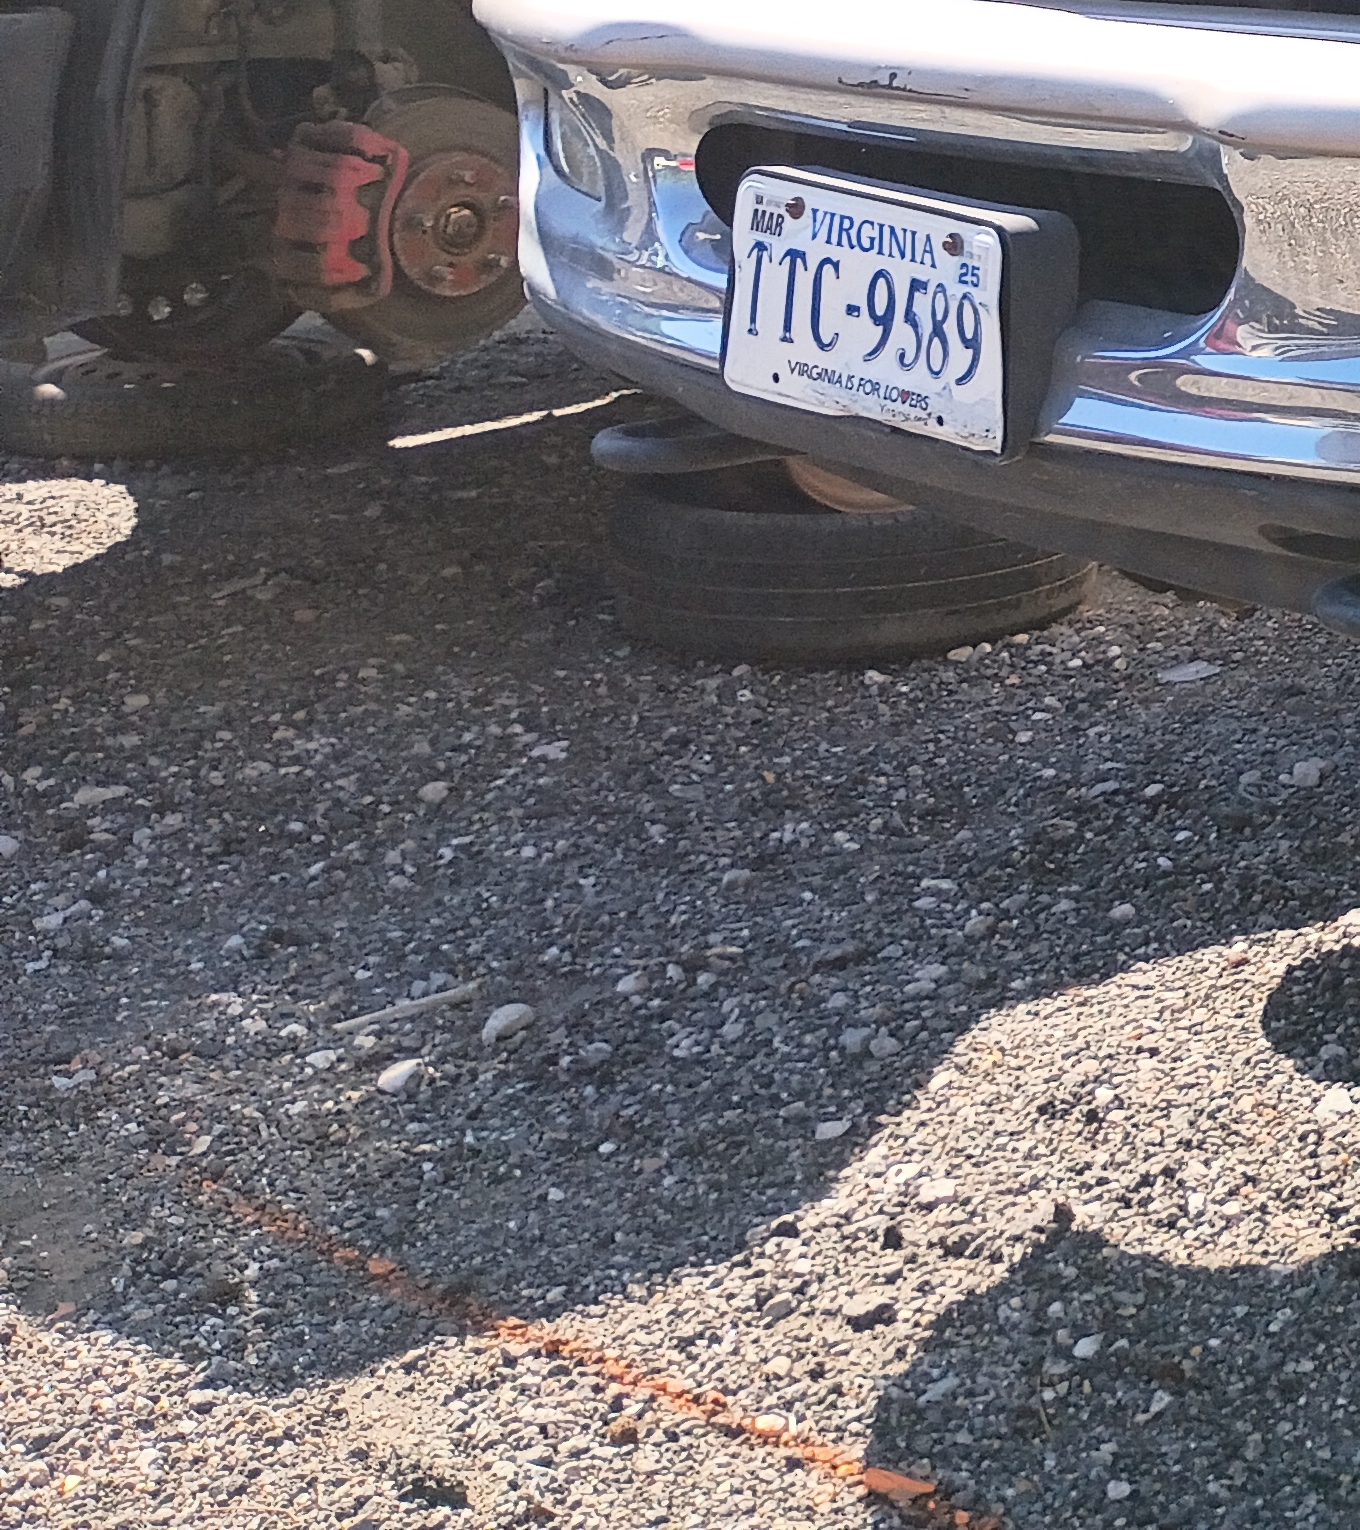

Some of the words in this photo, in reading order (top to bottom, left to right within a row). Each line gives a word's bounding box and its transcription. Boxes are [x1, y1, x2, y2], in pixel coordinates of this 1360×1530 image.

[751, 209, 784, 236] MAR
[811, 208, 937, 268] VIRGINIA
[958, 263, 980, 287] 25
[747, 240, 982, 385] TTC-9589
[788, 360, 842, 387] VIRGINIA
[845, 374, 855, 390] IS
[856, 377, 880, 399] FOR
